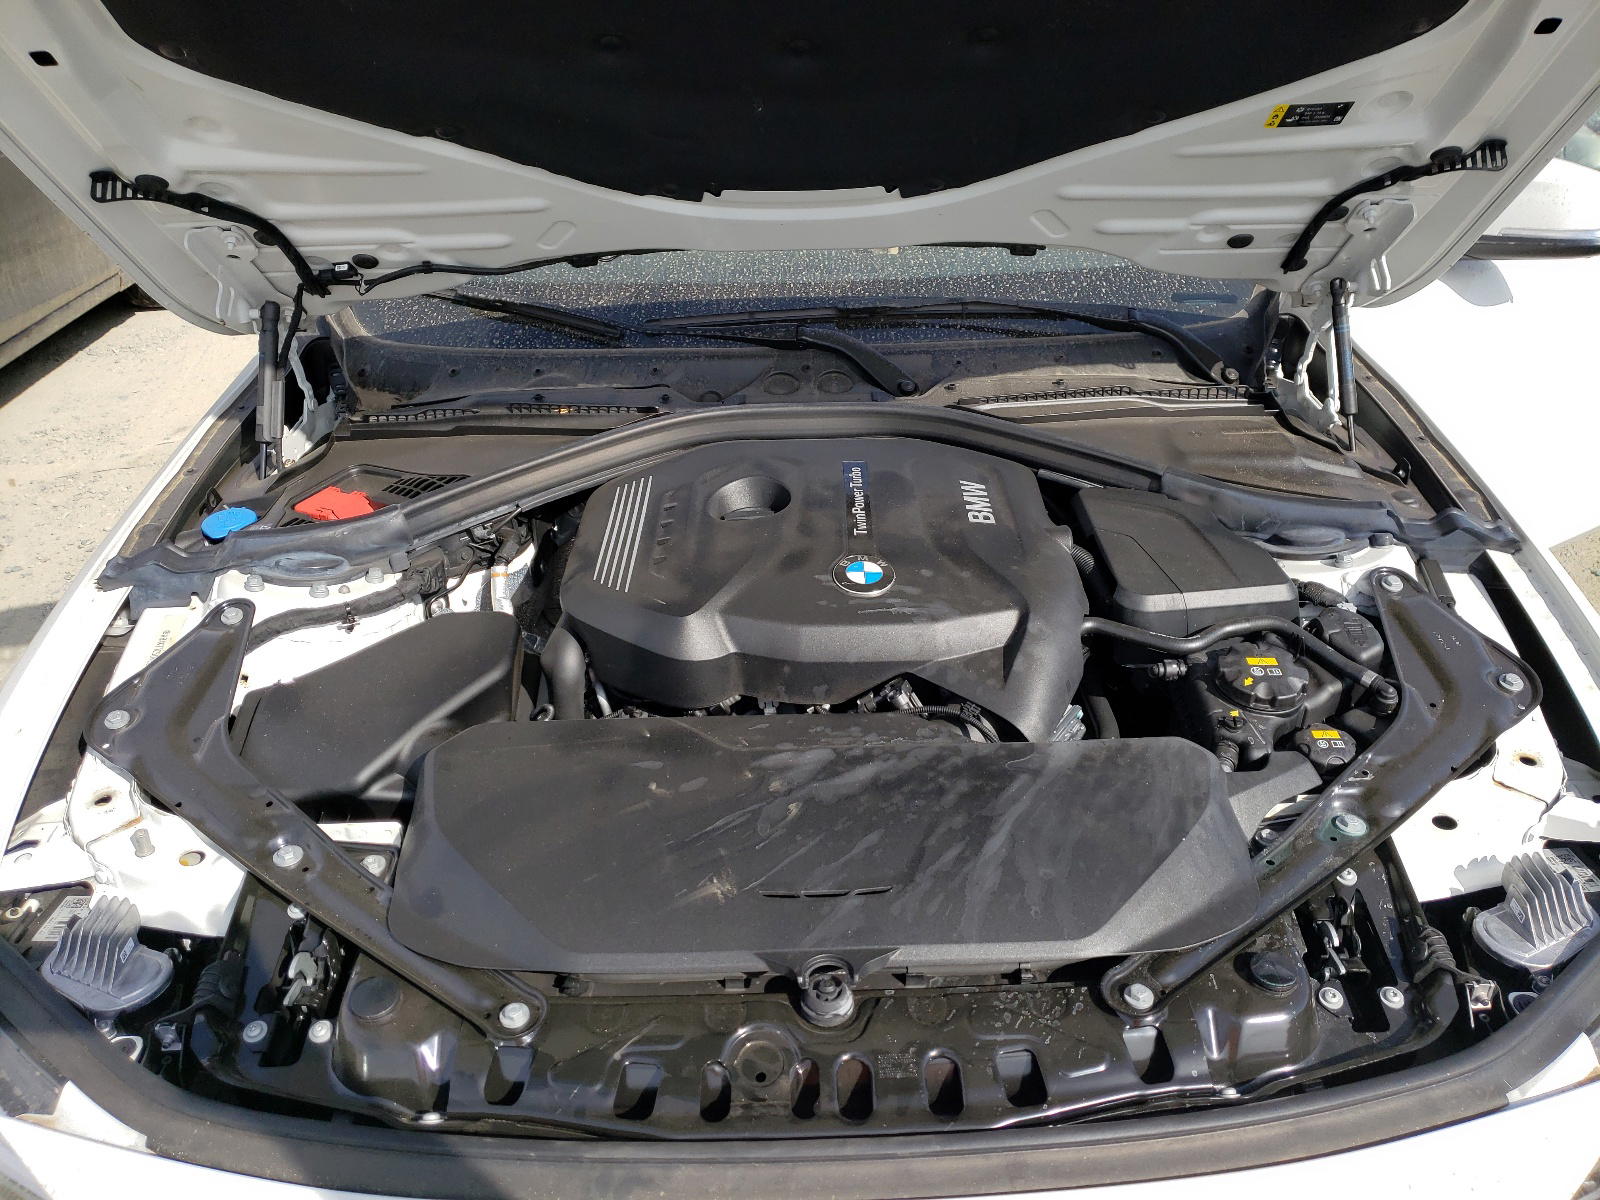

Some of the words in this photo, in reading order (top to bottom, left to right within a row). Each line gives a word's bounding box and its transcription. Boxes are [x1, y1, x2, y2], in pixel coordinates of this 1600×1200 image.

[849, 467, 862, 488] Turbo
[852, 488, 867, 536] TwinPower
[959, 480, 996, 524] BMW
[839, 554, 888, 567] BMW
